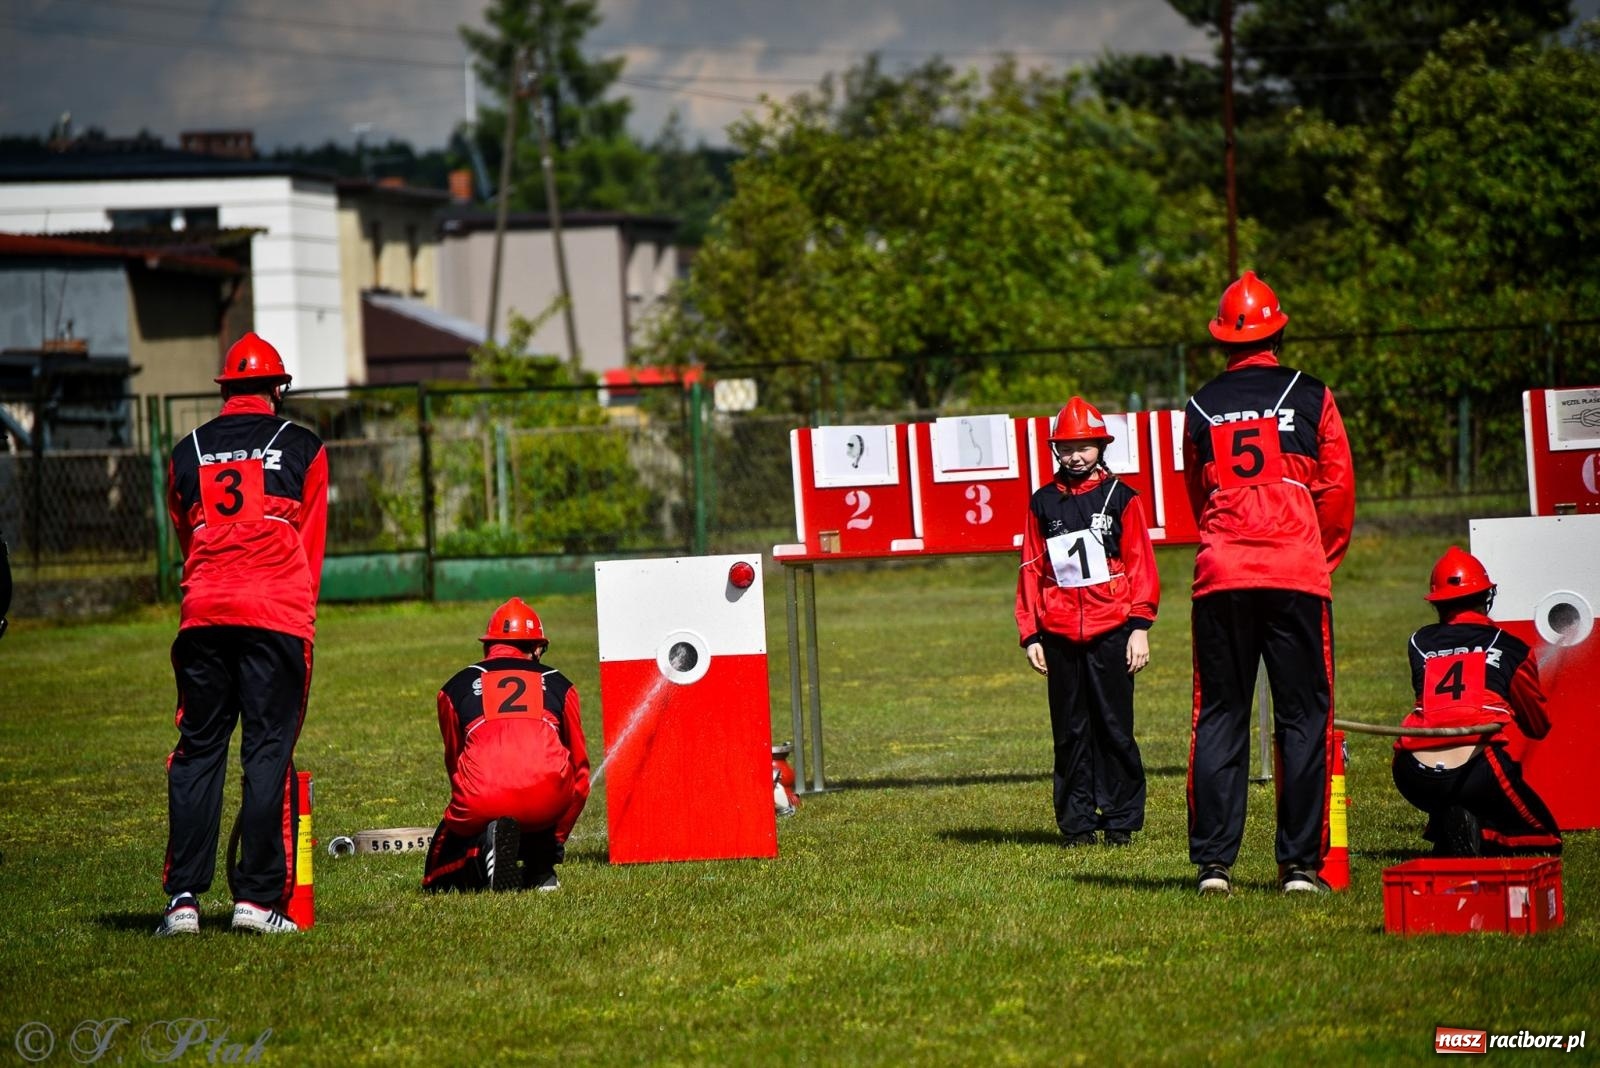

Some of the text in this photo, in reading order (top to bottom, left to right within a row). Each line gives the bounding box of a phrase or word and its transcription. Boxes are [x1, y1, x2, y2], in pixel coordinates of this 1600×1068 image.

[1231, 427, 1265, 478] 5
[213, 468, 244, 517] 3
[845, 490, 873, 530] 2
[964, 484, 993, 525] 3
[1067, 536, 1091, 580] 1
[497, 676, 528, 713] 2
[1435, 660, 1466, 701] 4
